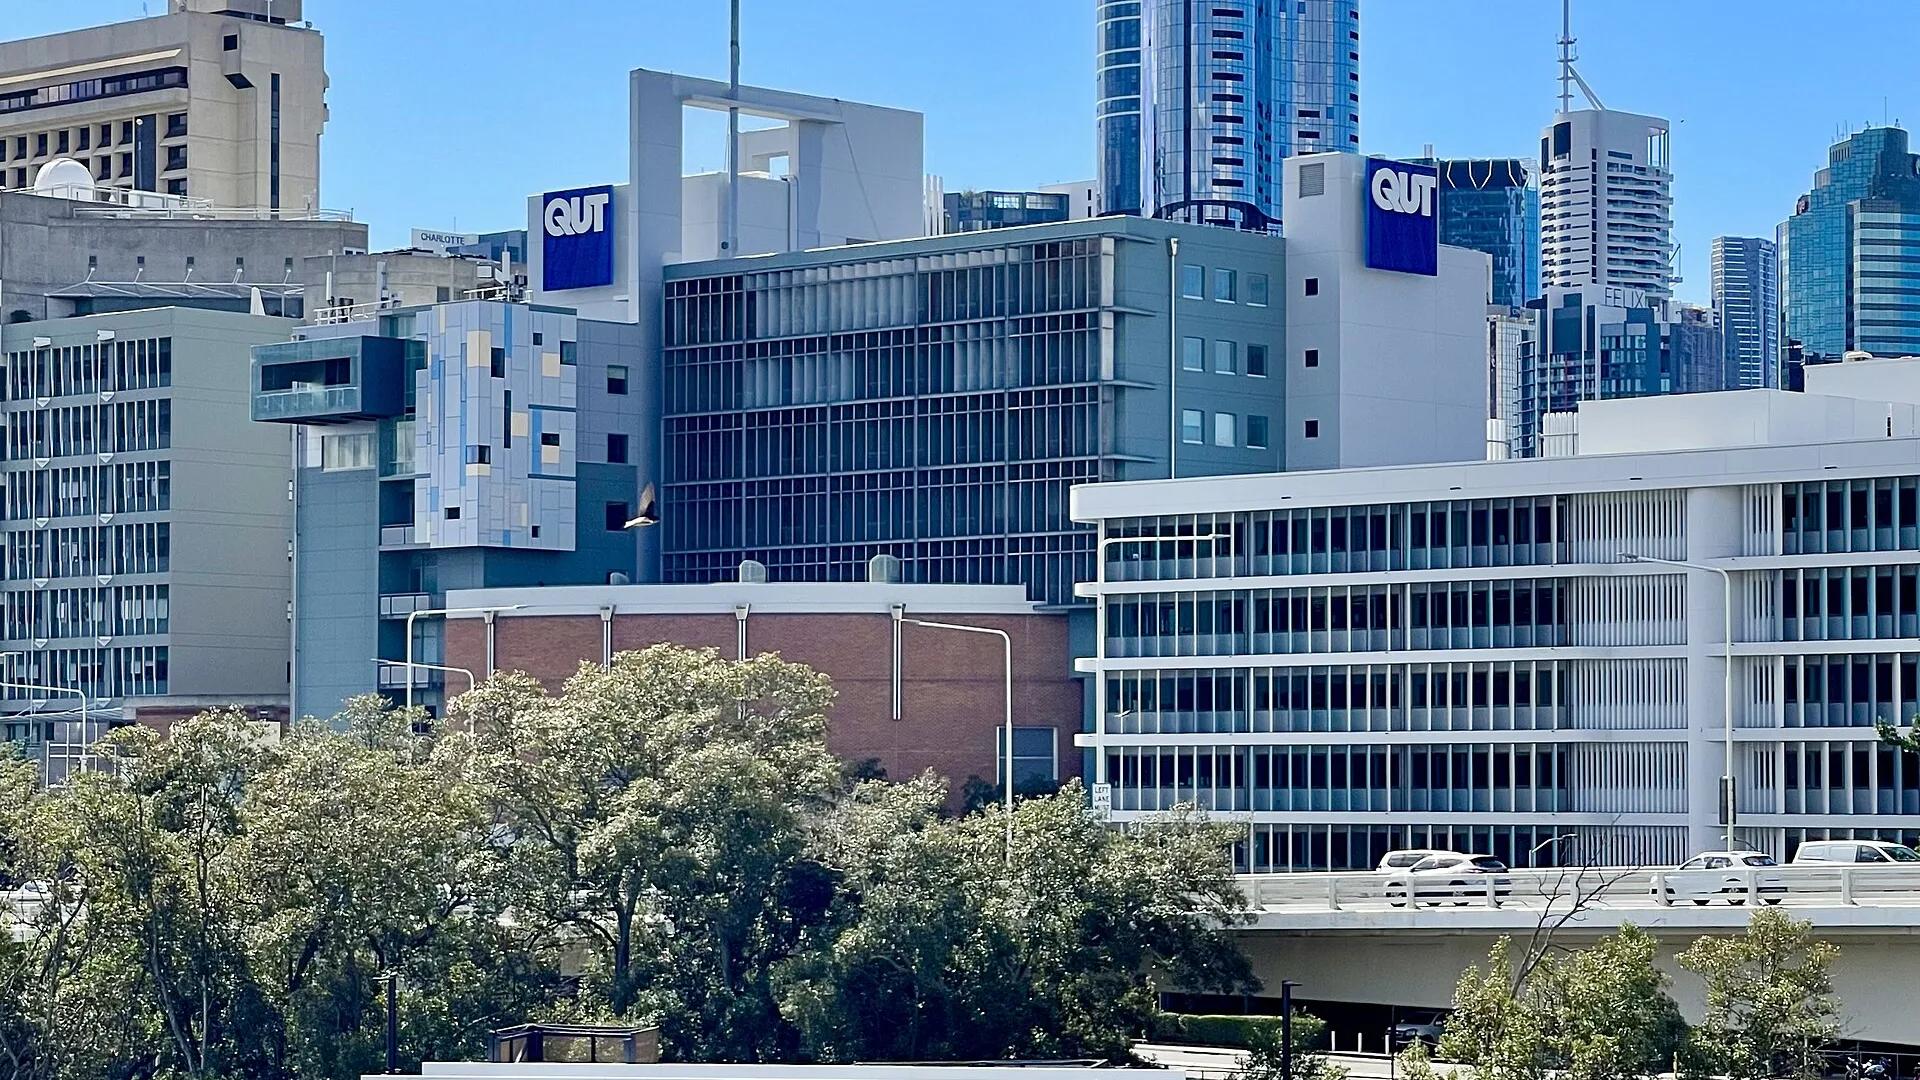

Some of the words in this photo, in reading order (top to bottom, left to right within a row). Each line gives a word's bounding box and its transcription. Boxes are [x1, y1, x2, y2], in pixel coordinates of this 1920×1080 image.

[1372, 168, 1436, 216] QUT
[545, 193, 608, 236] QUT
[421, 233, 464, 245] CHARLOTTE
[1605, 287, 1644, 308] FELIX
